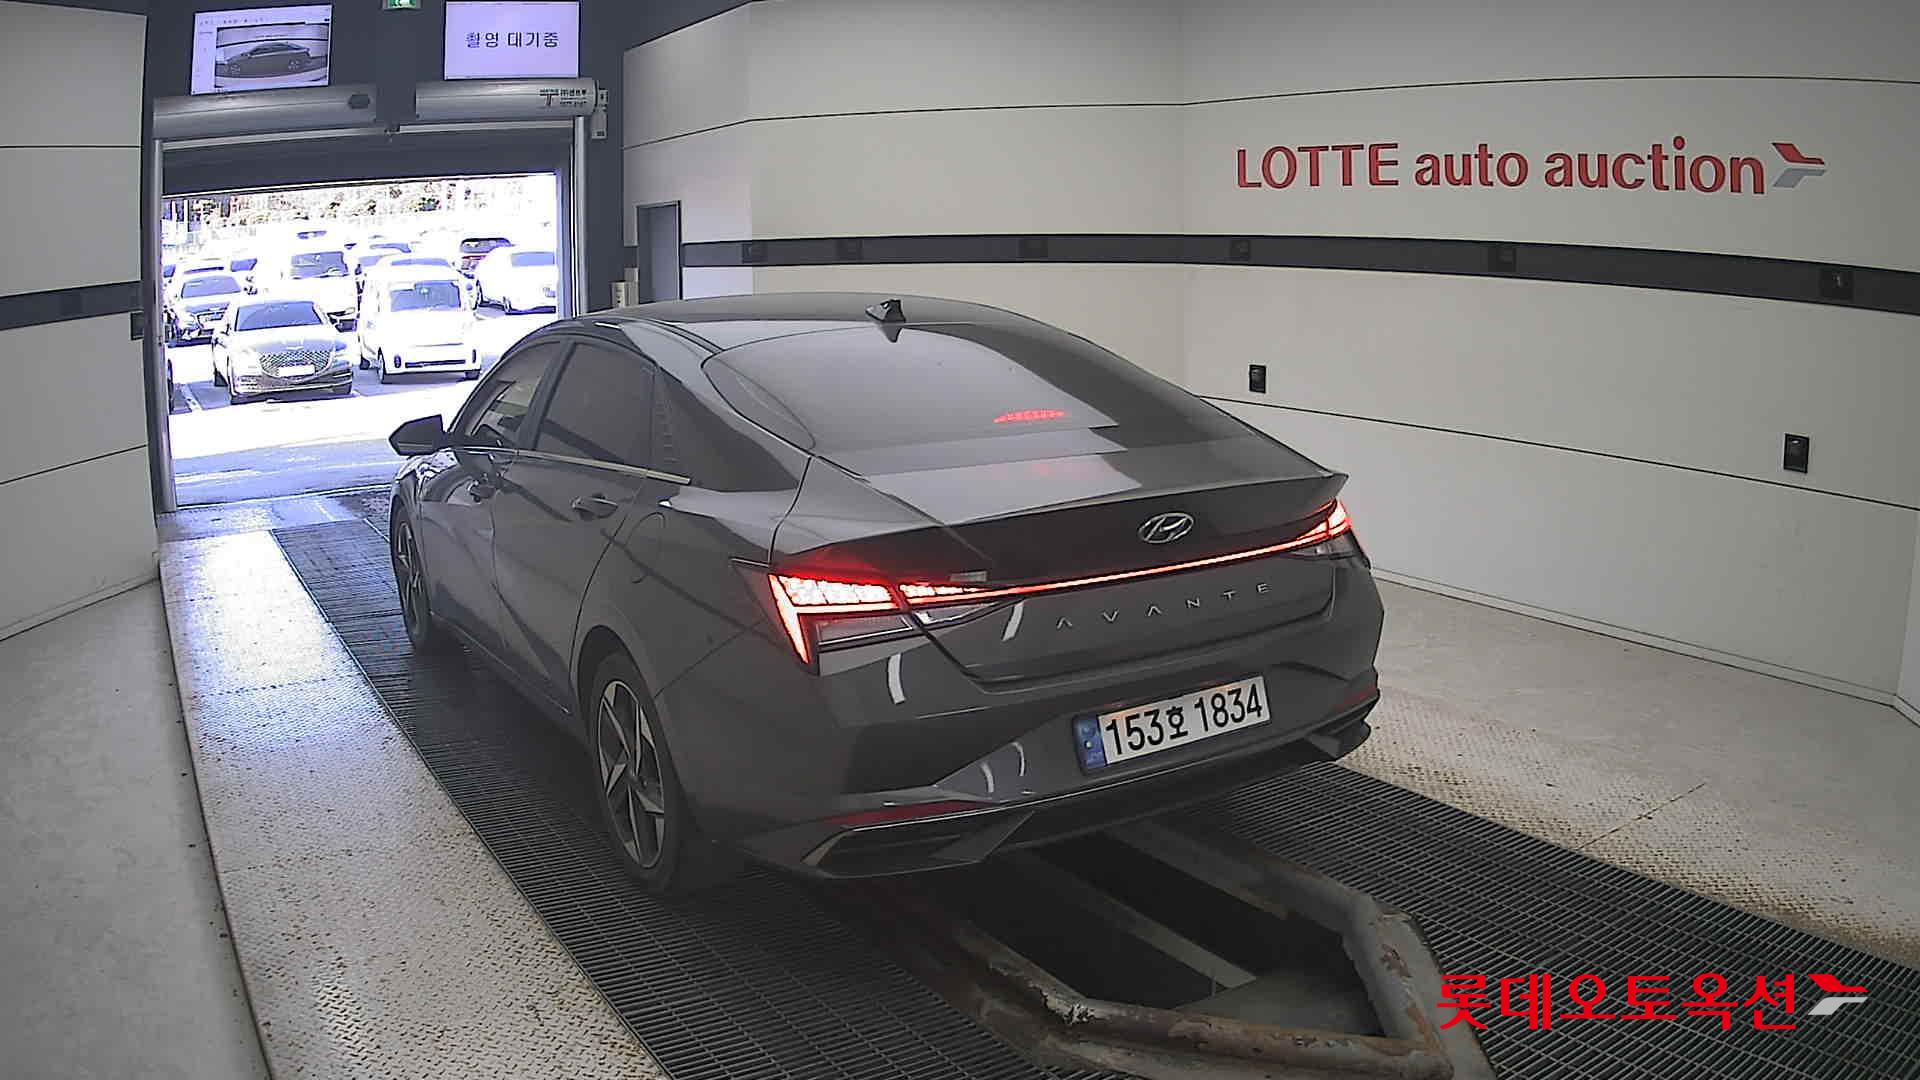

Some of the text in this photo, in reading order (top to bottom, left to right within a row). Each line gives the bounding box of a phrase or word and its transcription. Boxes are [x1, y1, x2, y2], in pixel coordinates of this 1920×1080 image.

[507, 31, 559, 48] 대기중
[1236, 136, 1765, 195] LOTTE auto auction
[1056, 582, 1270, 629] AVANTE
[1105, 683, 1262, 755] 153호 1834
